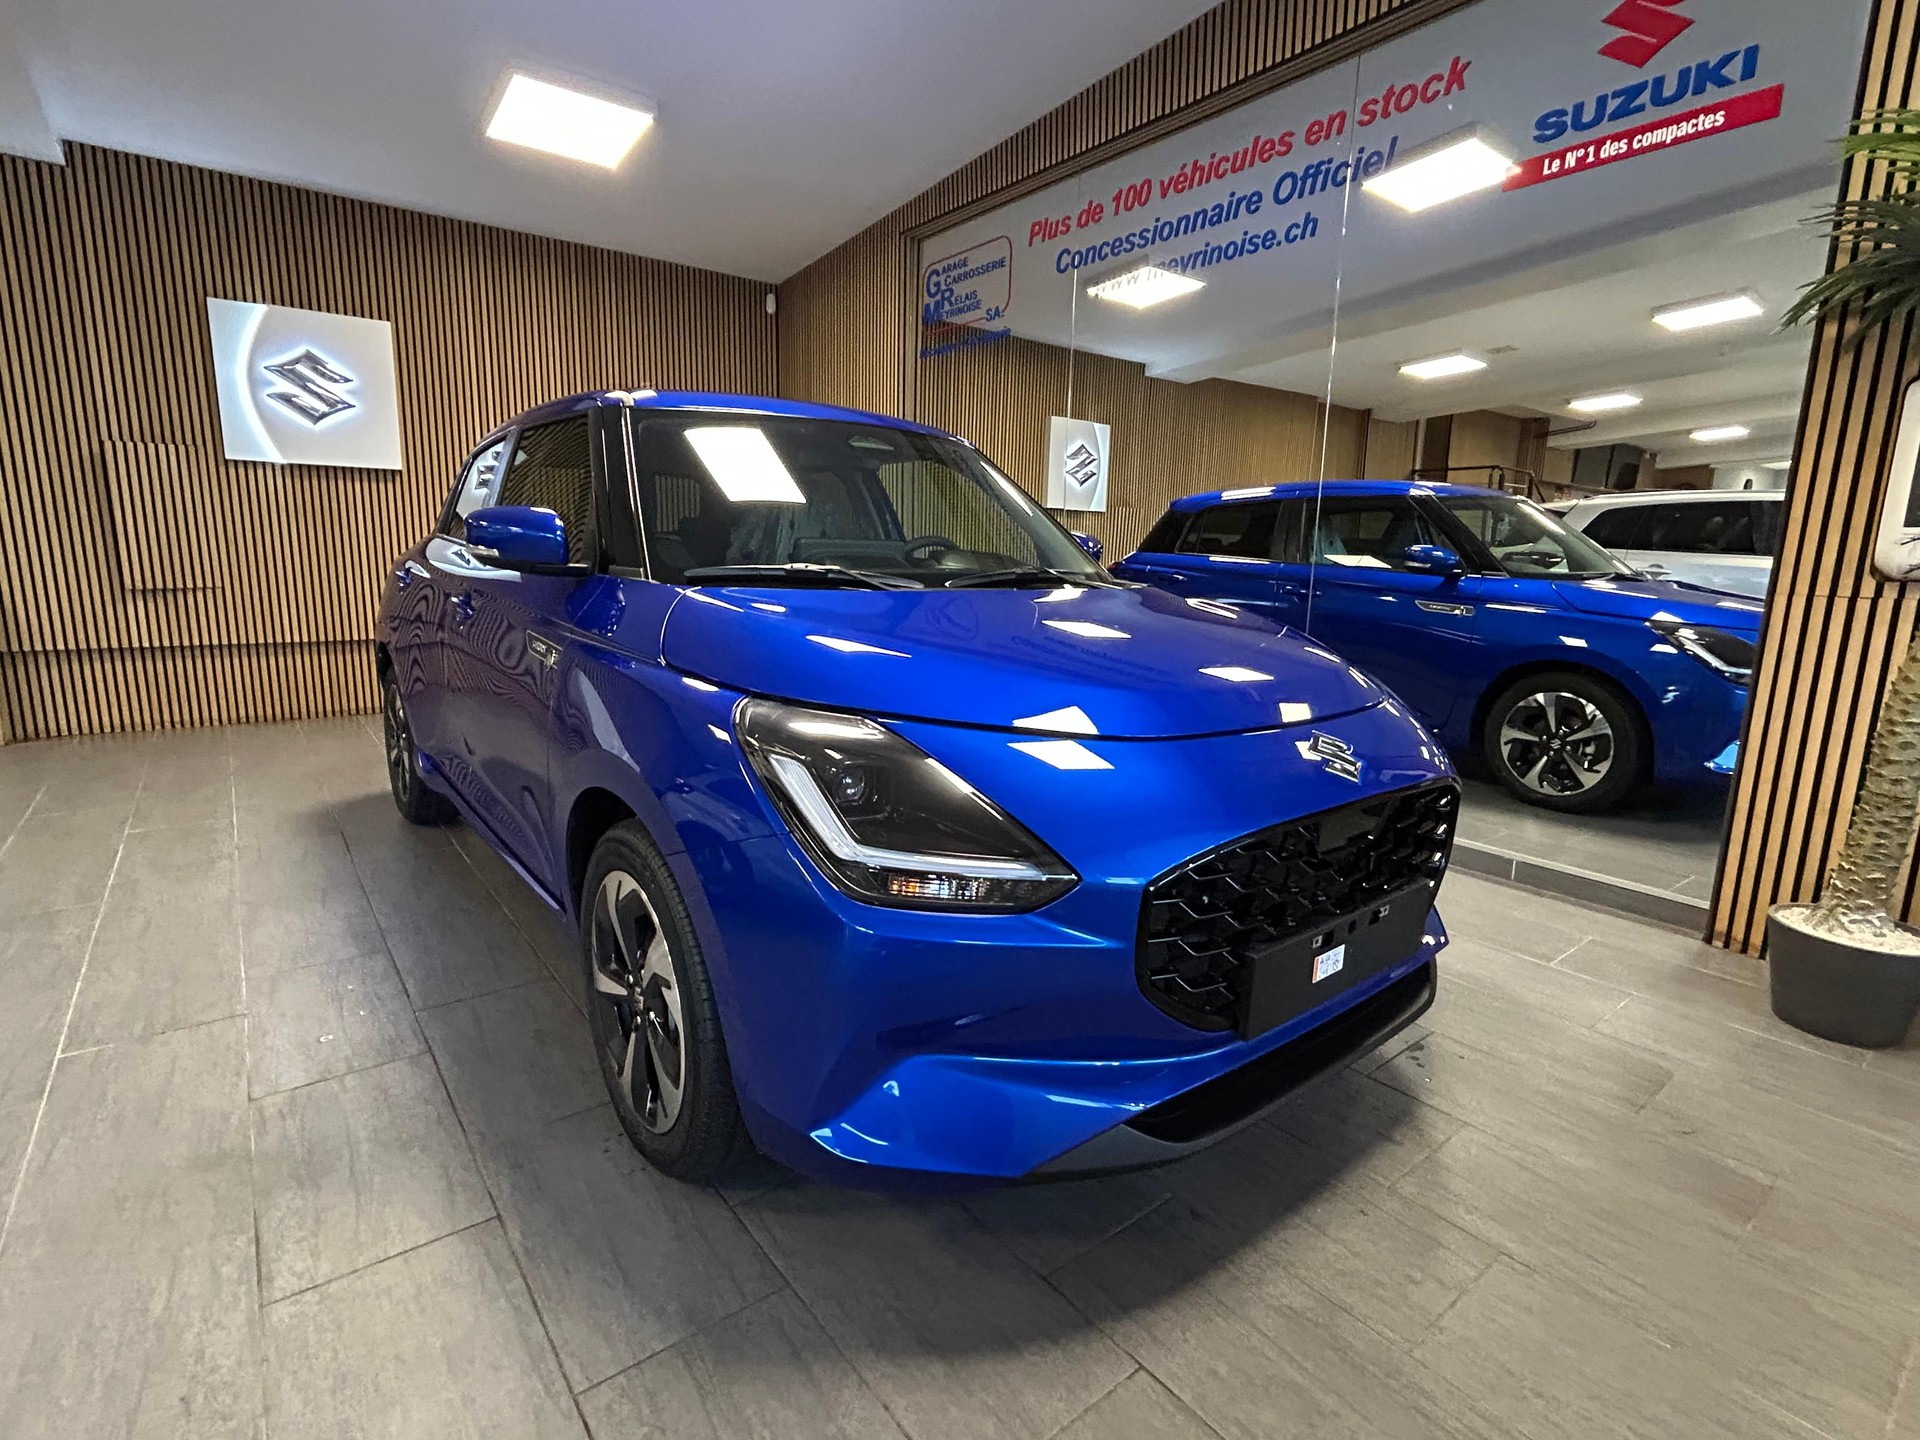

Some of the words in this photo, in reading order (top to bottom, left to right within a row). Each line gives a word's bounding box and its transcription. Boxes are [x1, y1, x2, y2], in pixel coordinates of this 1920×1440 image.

[1532, 44, 1759, 143] SUZUKI
[1028, 214, 1072, 247] Plus
[1077, 199, 1104, 229] de
[1112, 178, 1152, 216] 100
[1159, 131, 1296, 200] véhicules
[1304, 110, 1347, 146] en
[1357, 56, 1472, 127] stock
[1542, 156, 1560, 176] Le
[1600, 134, 1628, 160] des
[1633, 109, 1726, 150] compactes
[1056, 189, 1263, 274] Concessionnaire
[1273, 135, 1399, 206] Officiel
[944, 256, 1007, 287] CARROSSERIE
[1093, 211, 1319, 295] wwwmeyrinoise.ch
[940, 287, 978, 310] RELAIS
